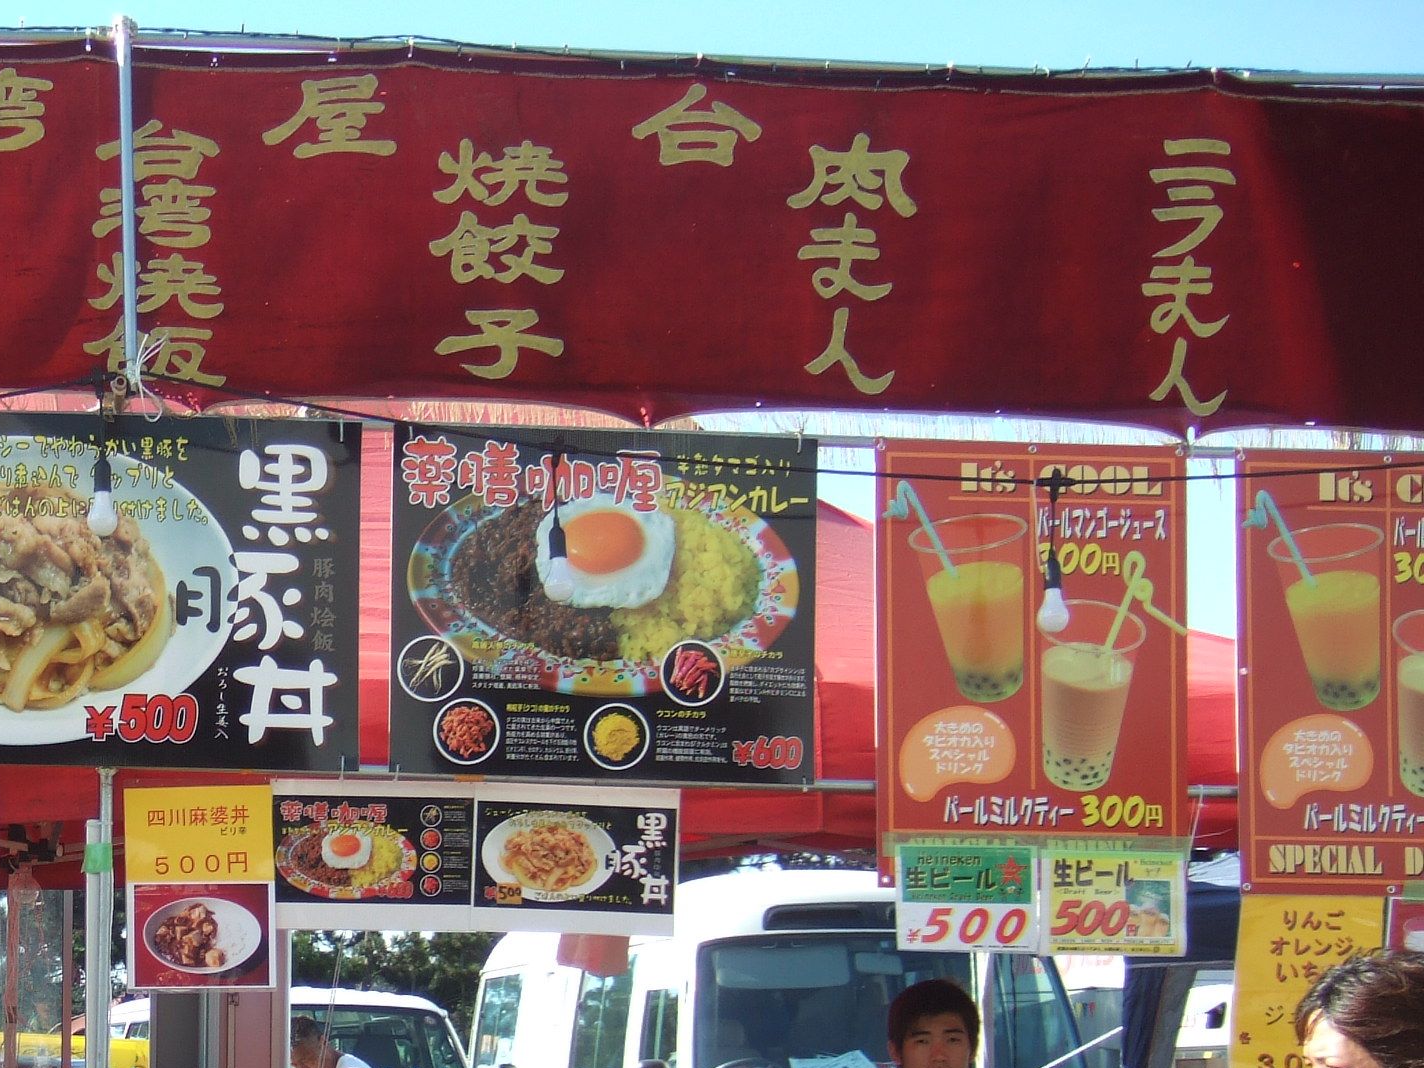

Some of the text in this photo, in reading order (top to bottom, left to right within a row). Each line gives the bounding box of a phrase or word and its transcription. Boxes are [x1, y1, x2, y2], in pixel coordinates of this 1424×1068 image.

[429, 138, 569, 380] 焼餃子
[786, 133, 917, 395] 肉まん
[1039, 463, 1163, 495] COOL
[1319, 471, 1374, 502] It's
[666, 482, 809, 513] アジアンカレー
[85, 693, 199, 744] ¥500
[732, 735, 804, 770] ¥600
[147, 804, 250, 827] 四川麻婆丼
[943, 795, 1164, 829] パールミルクティー 300円
[155, 851, 249, 875] 500円
[1053, 858, 1135, 888] 生ビール
[1268, 845, 1384, 876] SPECIAL
[906, 867, 998, 891] 生ビール
[1281, 910, 1346, 932] りんご
